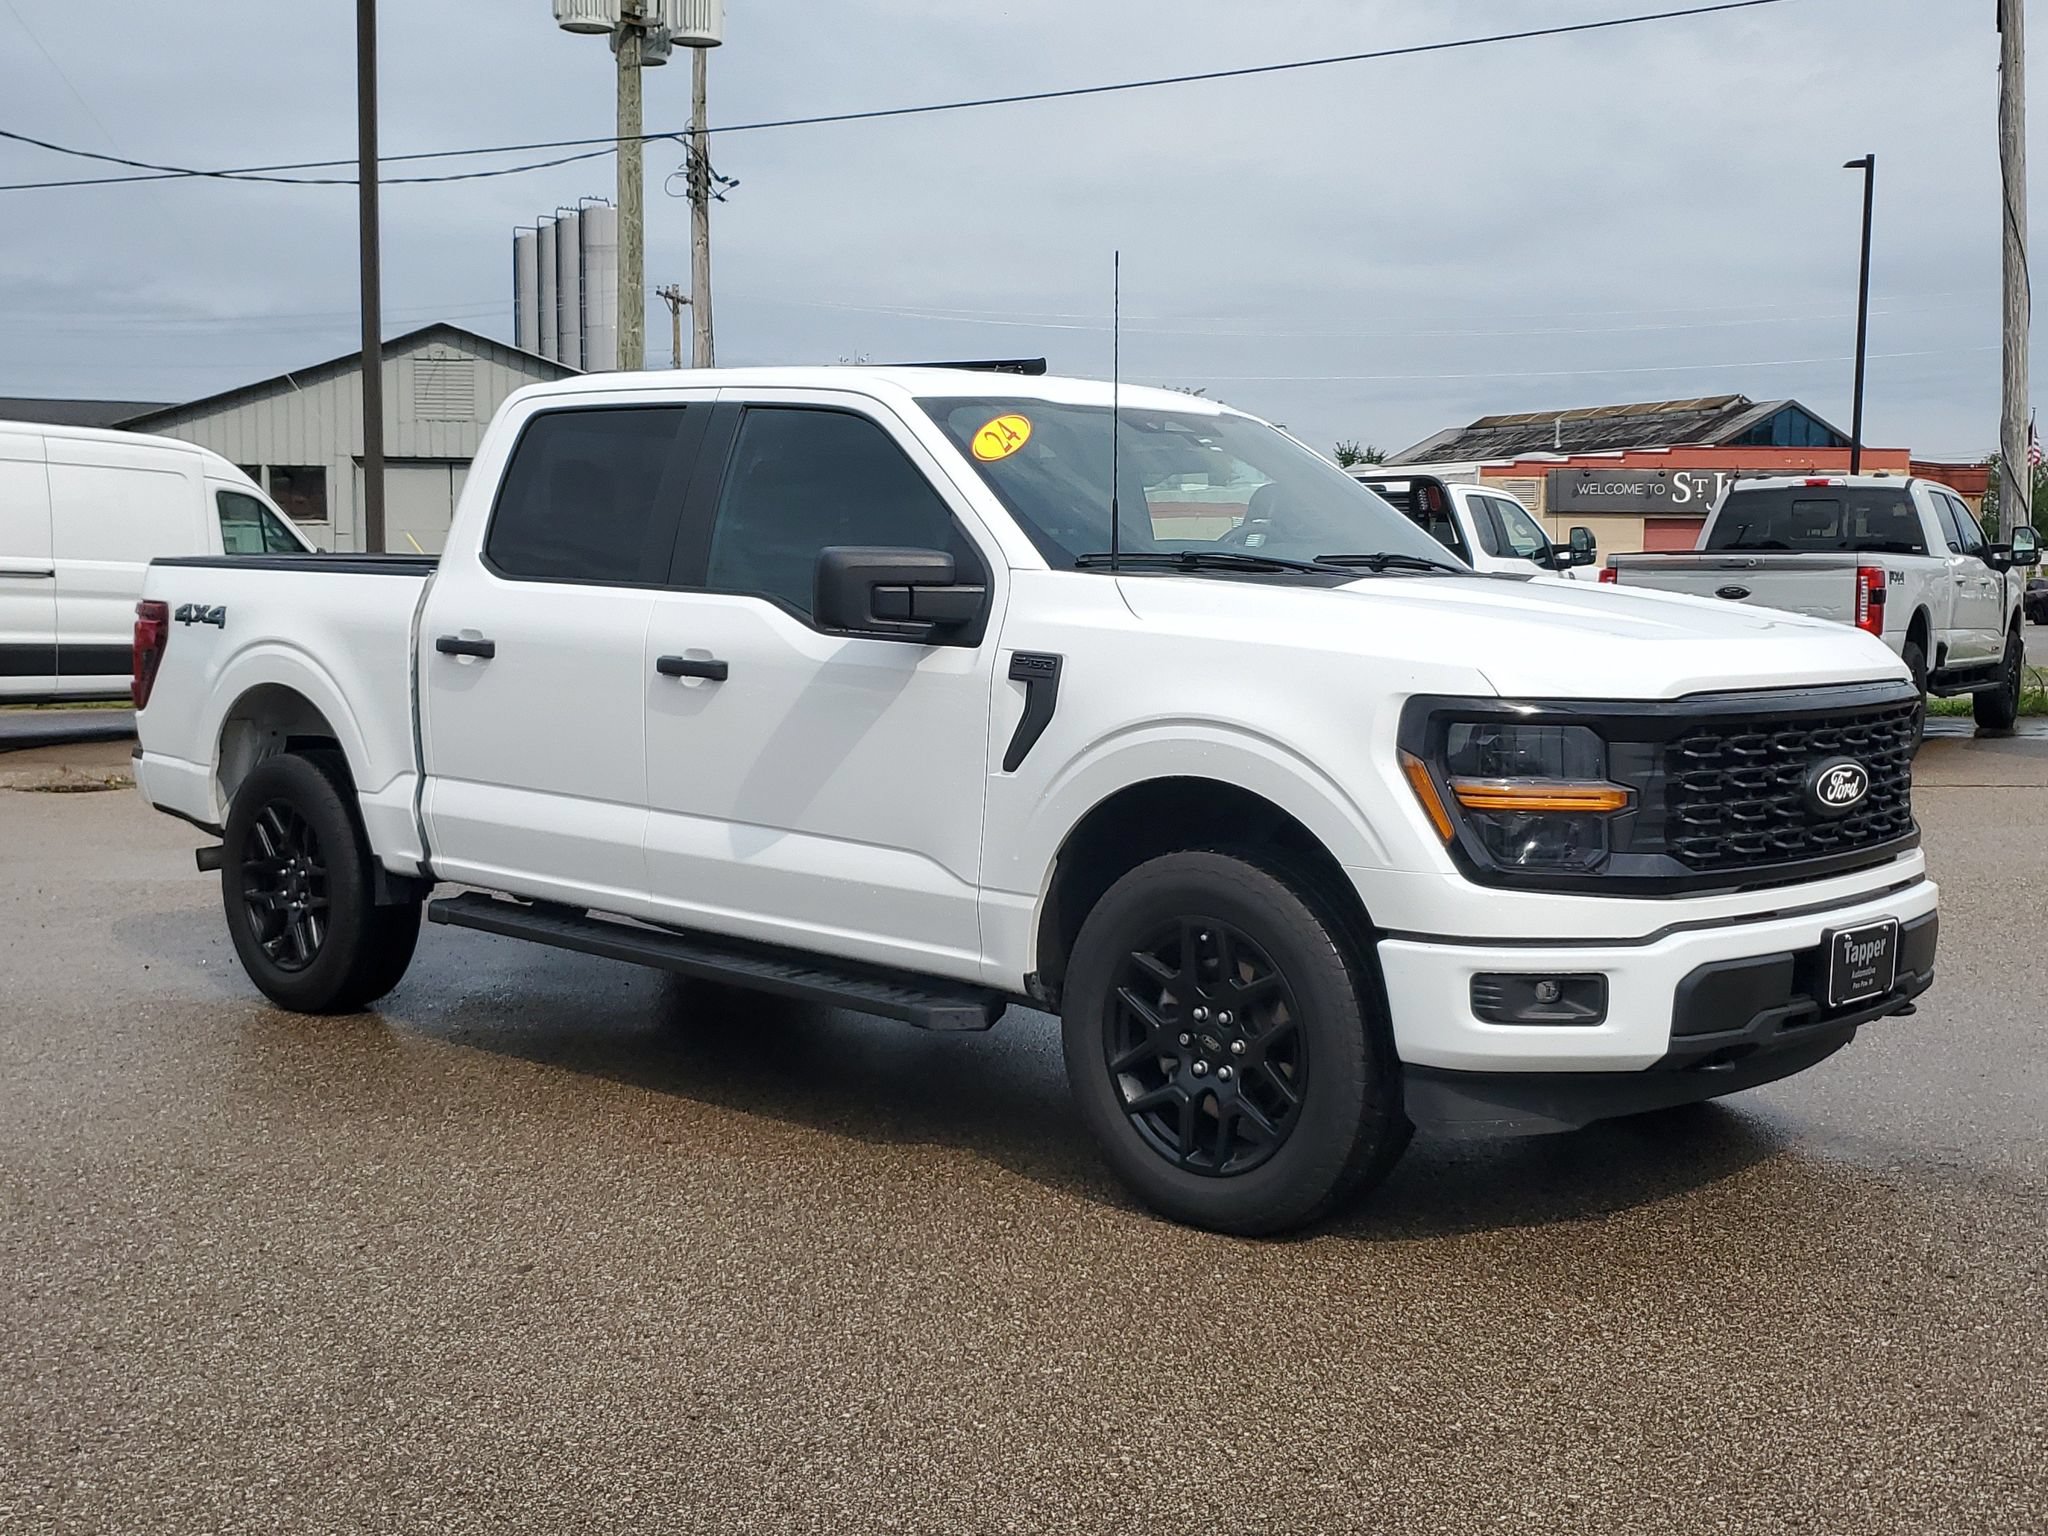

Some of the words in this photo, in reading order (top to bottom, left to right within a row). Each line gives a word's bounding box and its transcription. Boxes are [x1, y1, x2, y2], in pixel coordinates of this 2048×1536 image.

[984, 420, 1021, 453] 24
[1576, 482, 1643, 496] WELCOME
[1647, 483, 1666, 496] TO
[1827, 770, 1860, 801] Ford
[1843, 937, 1887, 967] Tapper
